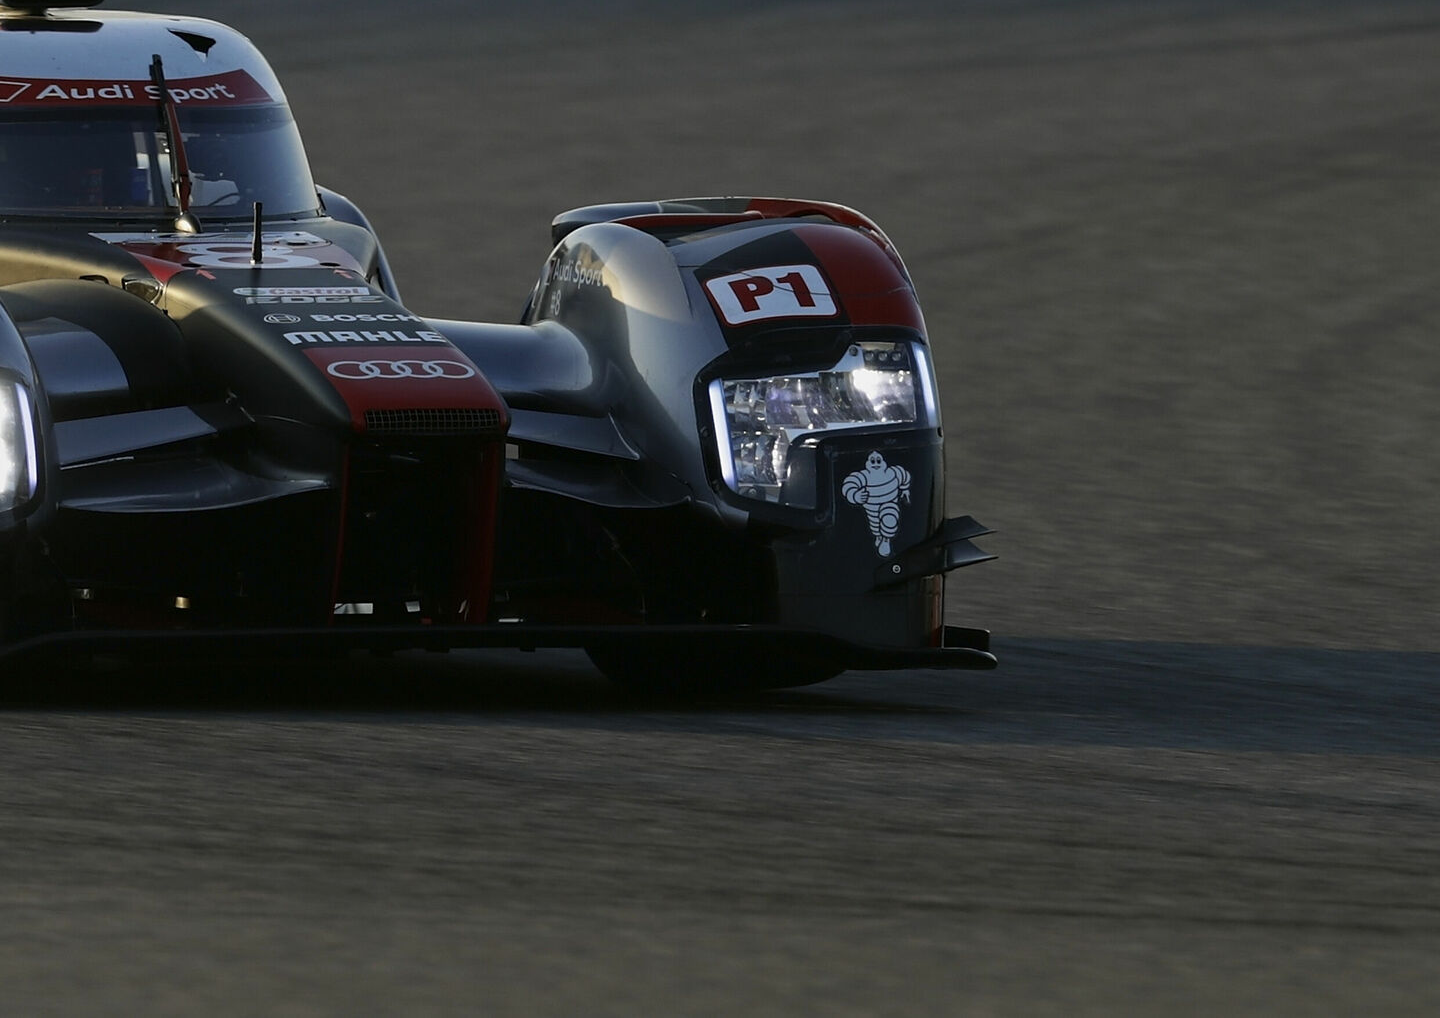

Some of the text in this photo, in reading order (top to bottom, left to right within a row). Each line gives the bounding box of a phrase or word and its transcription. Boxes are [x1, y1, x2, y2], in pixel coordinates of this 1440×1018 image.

[36, 83, 235, 103] Audi Sport
[176, 243, 320, 268] 8
[553, 258, 604, 289] Audi Sport
[246, 295, 385, 304] EDGE
[268, 287, 361, 295] Castrol
[728, 271, 817, 313] P1
[309, 313, 421, 322] BOSCH
[283, 331, 447, 346] MAHLE
